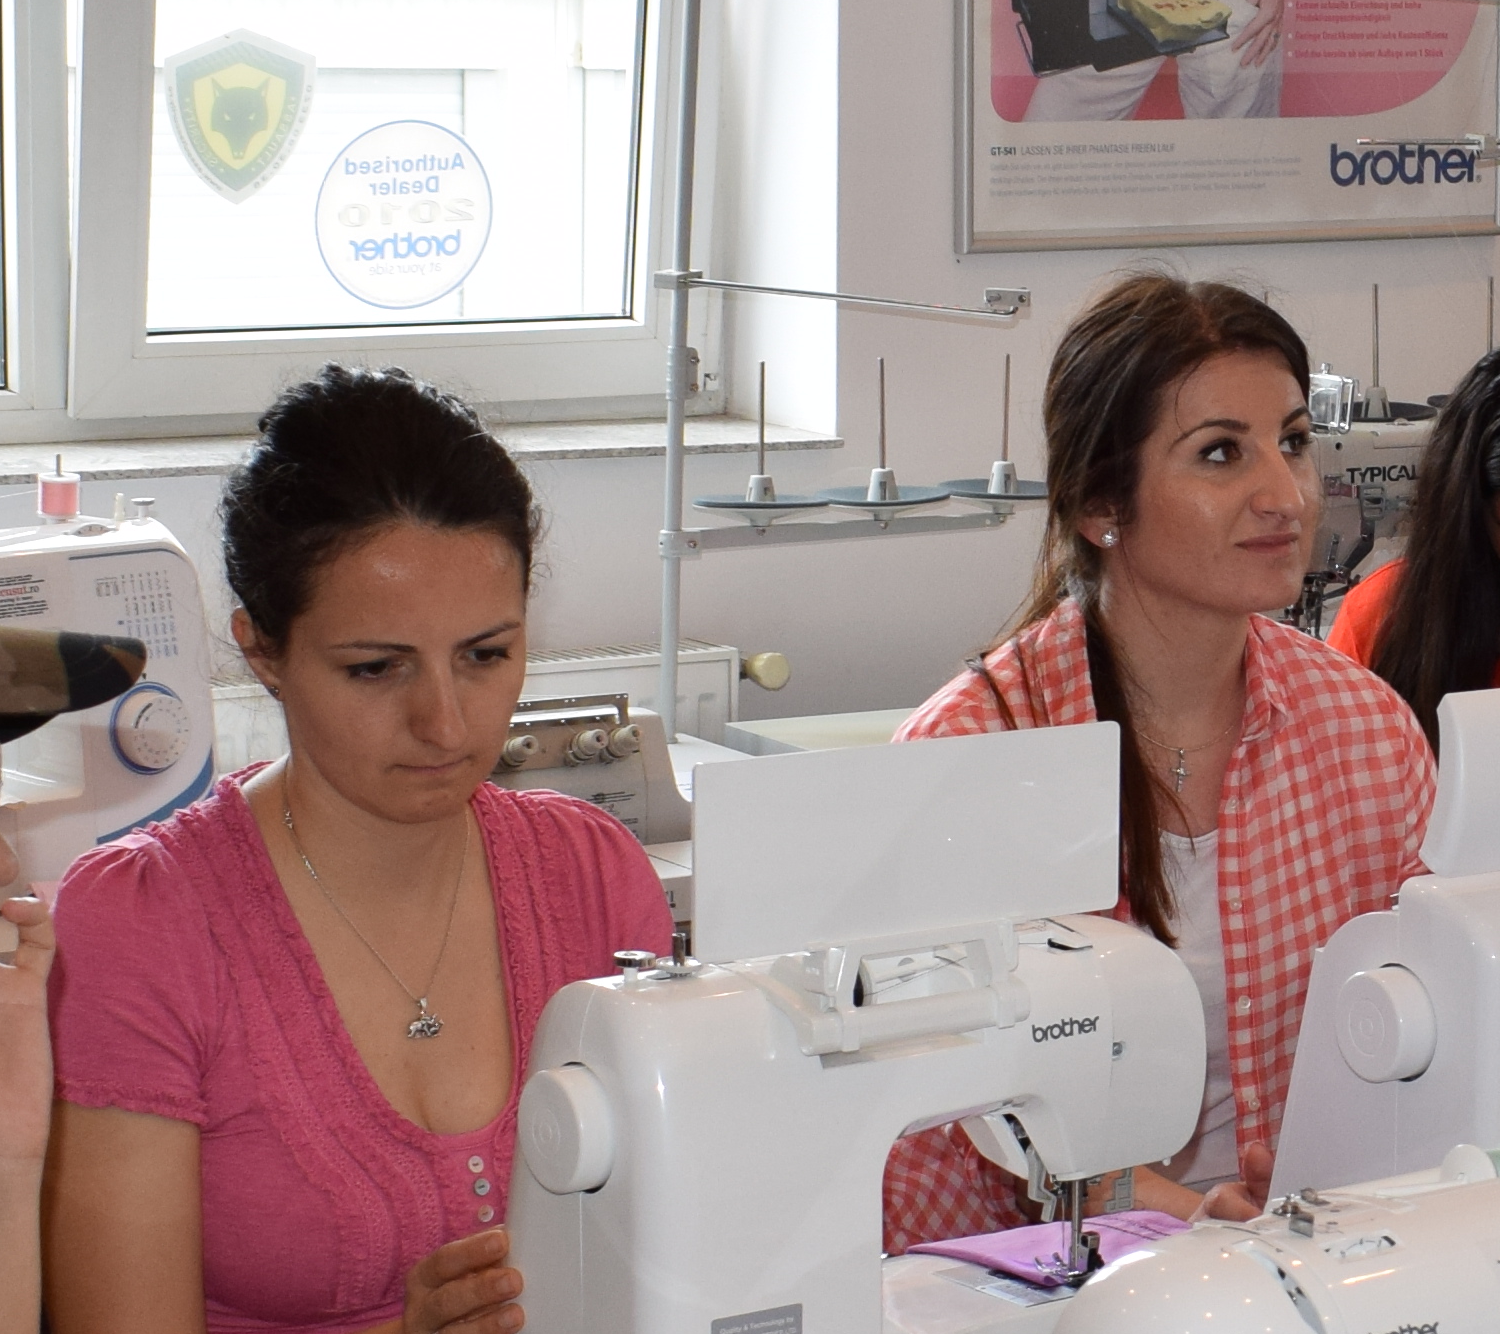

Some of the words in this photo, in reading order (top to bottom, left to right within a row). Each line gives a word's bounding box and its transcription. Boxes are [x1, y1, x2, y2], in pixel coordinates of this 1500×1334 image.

[990, 146, 1017, 156] GT-541
[1020, 145, 1051, 156] LASSEN
[1052, 145, 1065, 155] SIE
[1066, 144, 1087, 154] IHRER
[1088, 143, 1130, 154] PHANTASIE
[1329, 143, 1477, 188] brother
[1346, 464, 1419, 484] TYPICAL
[1031, 1014, 1100, 1045] brother
